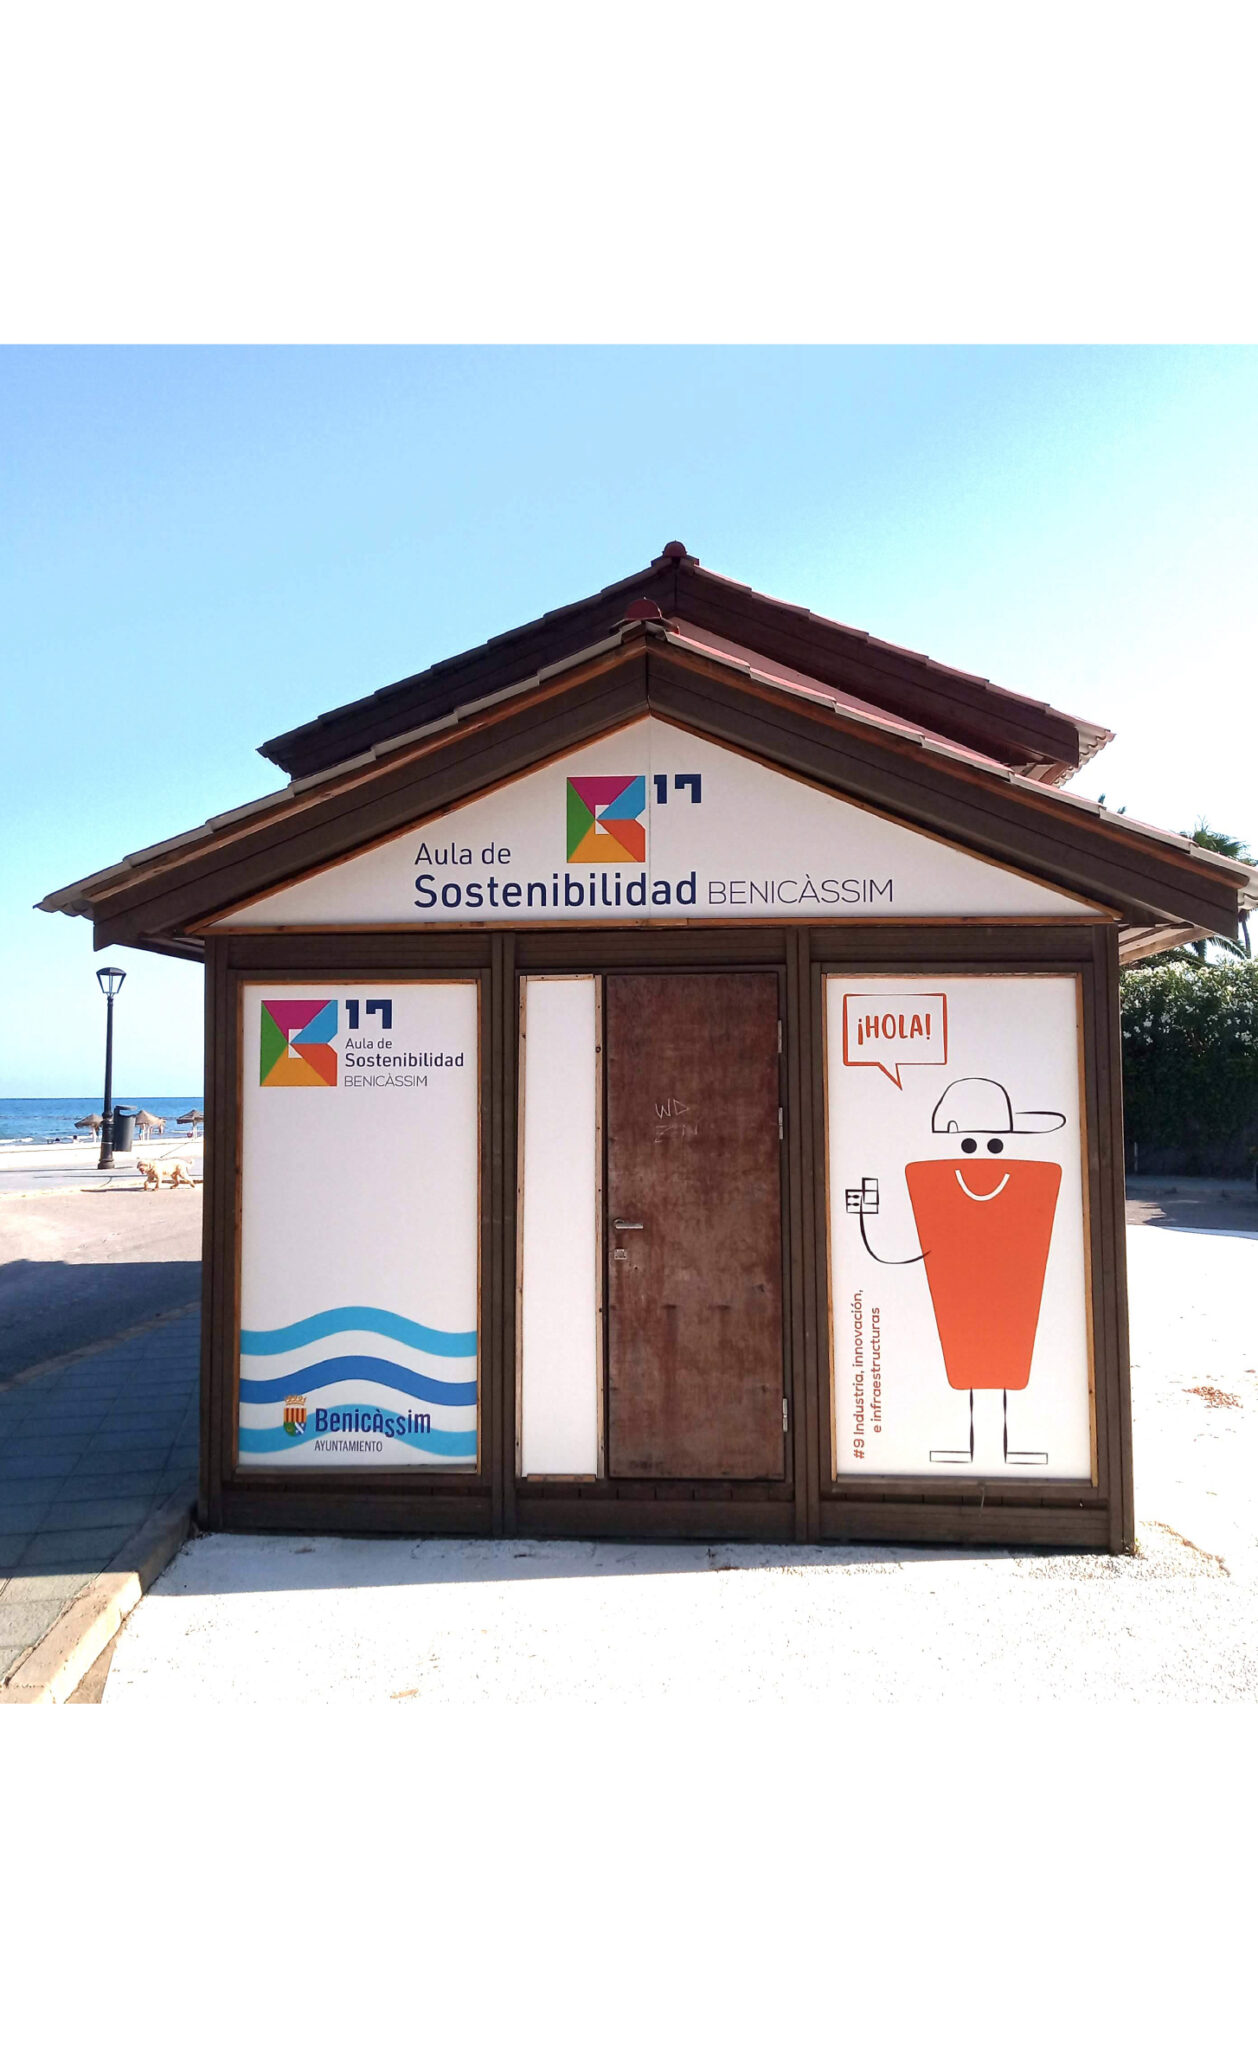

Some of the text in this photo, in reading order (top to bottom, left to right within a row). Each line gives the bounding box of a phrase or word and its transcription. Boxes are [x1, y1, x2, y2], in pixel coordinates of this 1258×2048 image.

[653, 773, 702, 804] 17
[414, 842, 512, 865] Aula de
[414, 871, 893, 908] Sostenibilidad BENICÀSSIM
[345, 999, 393, 1029] 17
[857, 1013, 931, 1045] ¡HOLA!
[345, 1038, 393, 1049] Aula de
[345, 1053, 464, 1068] Sostenibilidad
[344, 1073, 428, 1087] BENICÀSSIM
[851, 1289, 865, 1459] #9 Industria, innovación,
[870, 1307, 882, 1433] e infraestructuras
[314, 1440, 383, 1452] AYUNTAMIENTO
